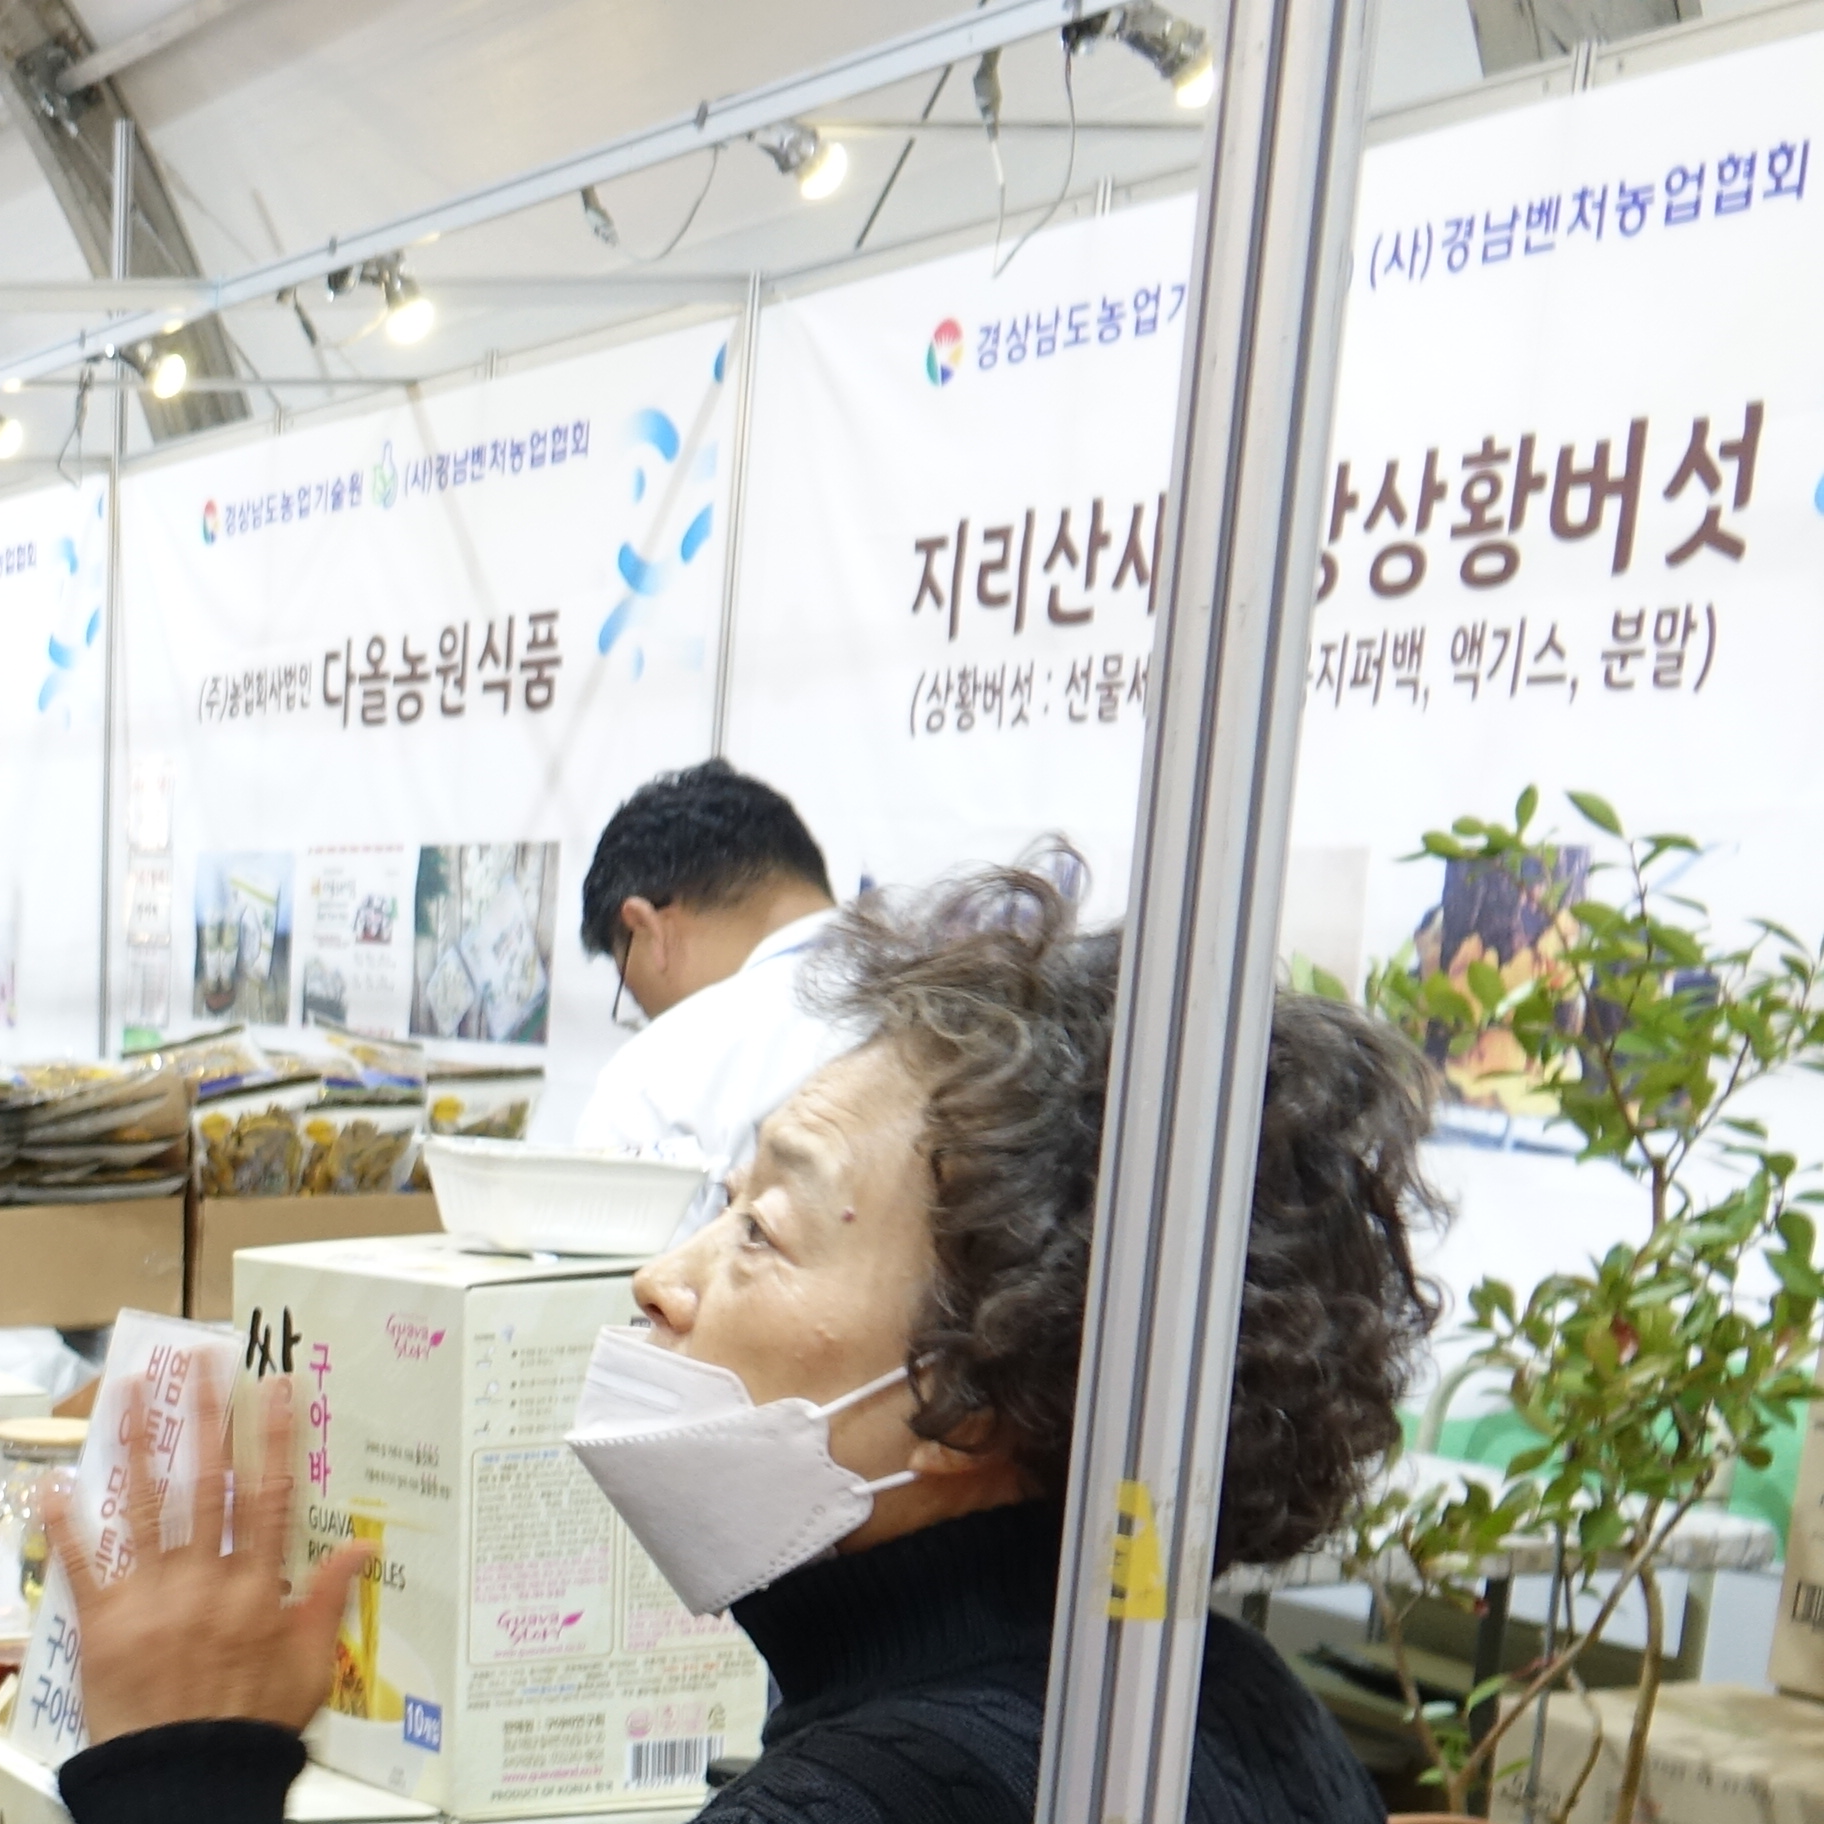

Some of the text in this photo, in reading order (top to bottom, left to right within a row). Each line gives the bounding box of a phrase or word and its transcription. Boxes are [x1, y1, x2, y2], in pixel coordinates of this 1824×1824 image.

[1368, 138, 1810, 290] (사)경남벤처농업협회
[225, 418, 591, 538] 경상남도농업기술원 (사)경남벤처농업협회
[198, 609, 563, 730] (주)농업회사법인 다올농원식품
[1601, 601, 1717, 694] 분말)
[309, 1342, 332, 1498] 구아바
[308, 1503, 357, 1539] GUAVA
[490, 1788, 539, 1803] PRODUCT
[541, 1786, 555, 1799] OF
[556, 1784, 592, 1799] KOREA
